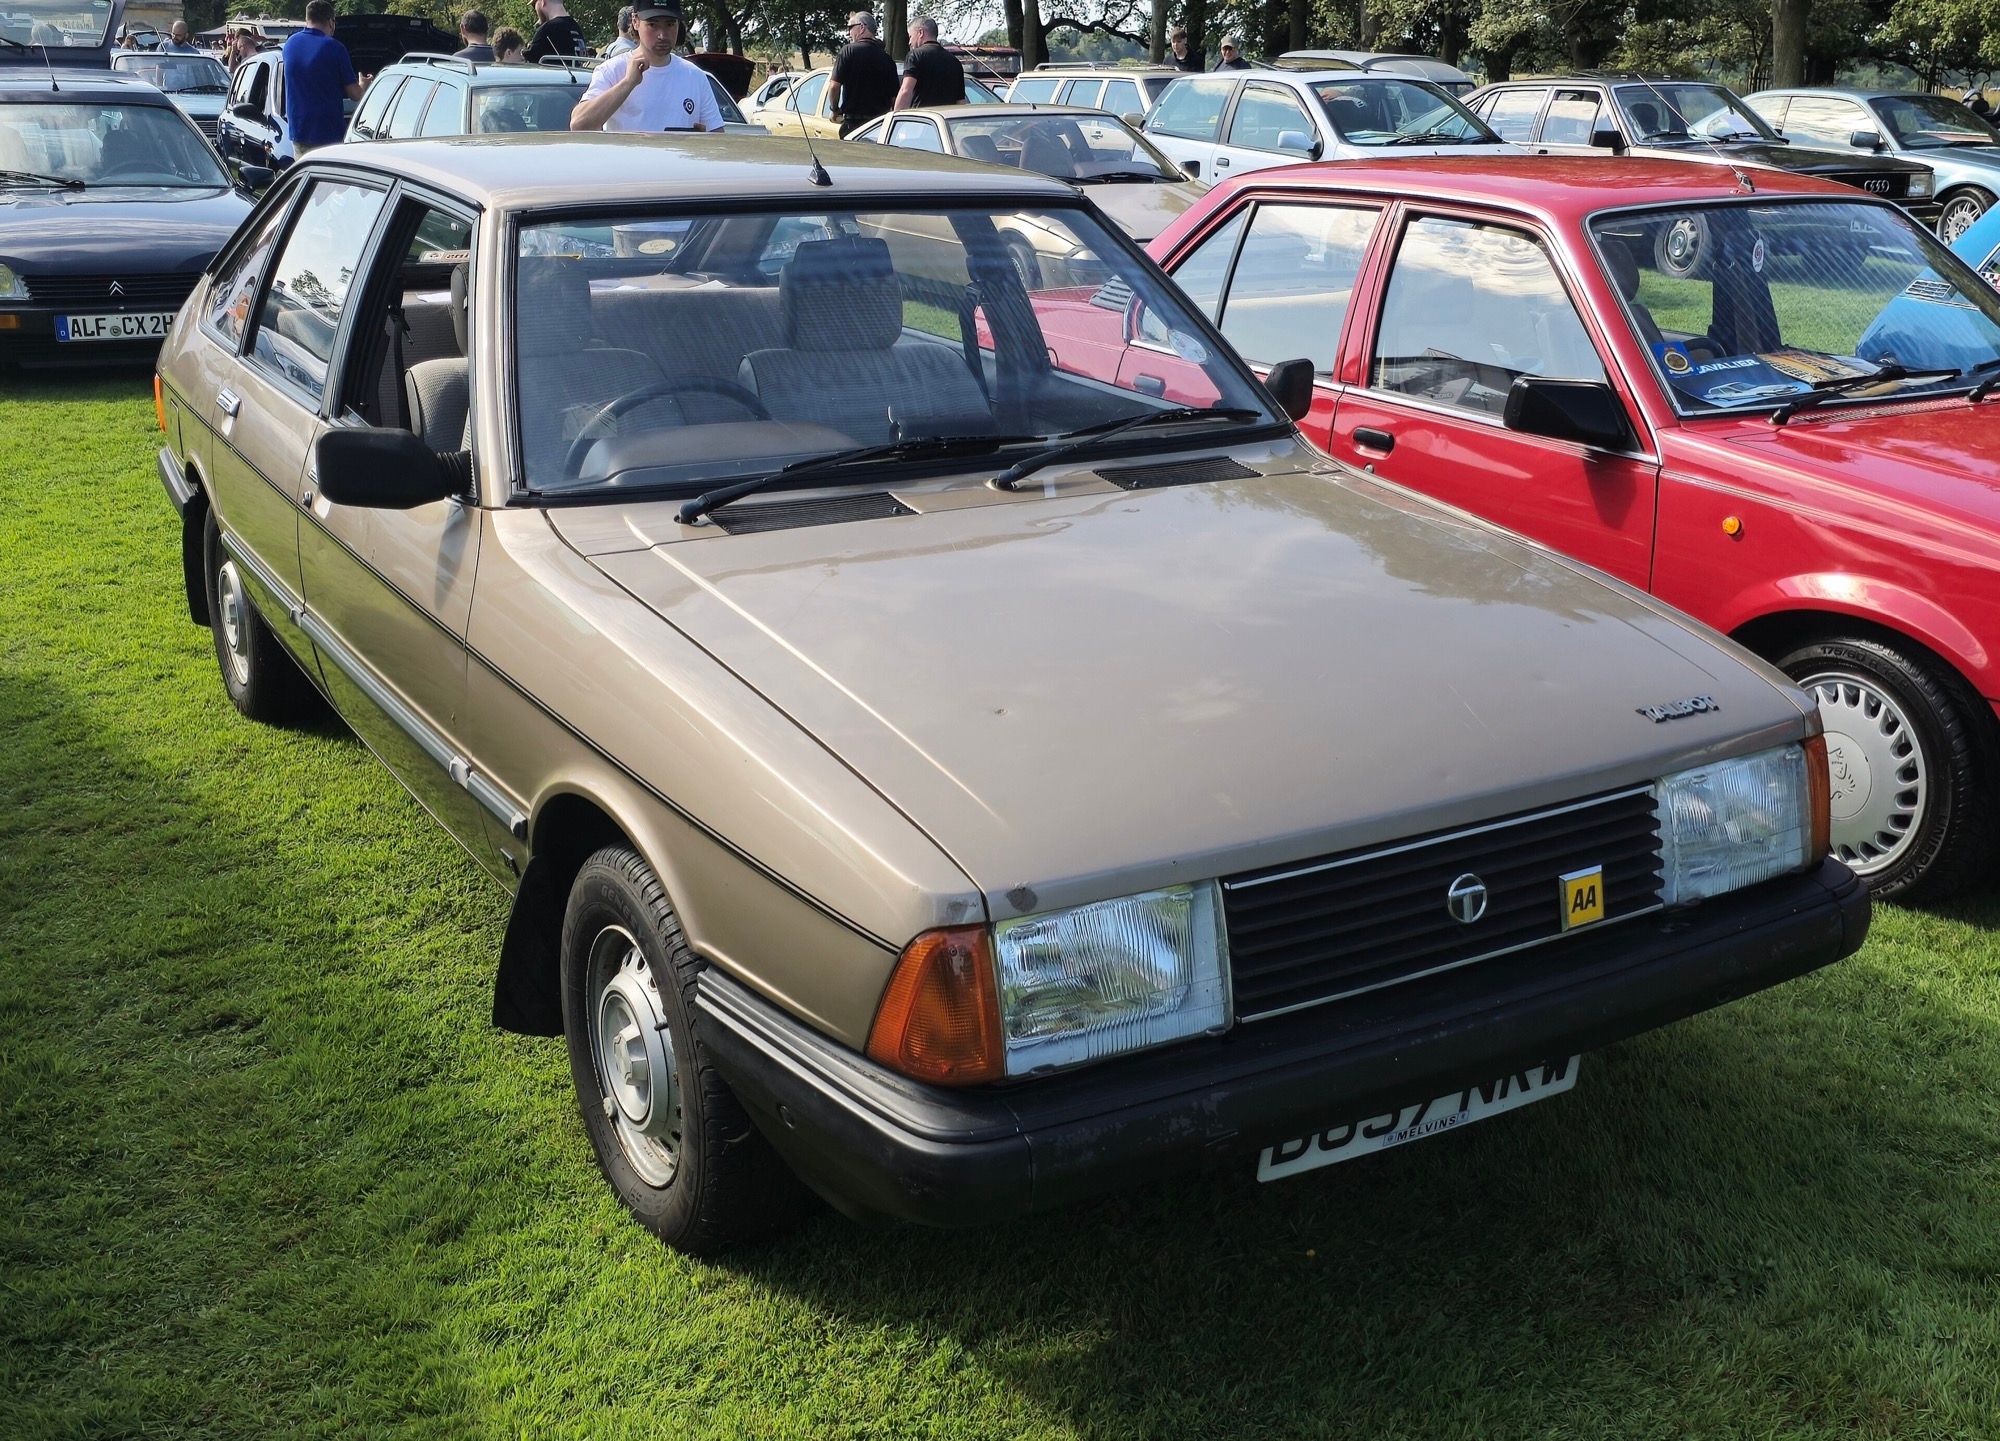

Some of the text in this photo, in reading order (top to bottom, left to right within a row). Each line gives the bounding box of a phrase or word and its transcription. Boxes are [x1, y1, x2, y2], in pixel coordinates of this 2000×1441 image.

[71, 317, 106, 338] ALF
[122, 316, 147, 336] CX
[1636, 694, 1719, 723] TALBOT
[1571, 884, 1597, 914] AA
[1397, 1115, 1456, 1141] MELVINS
